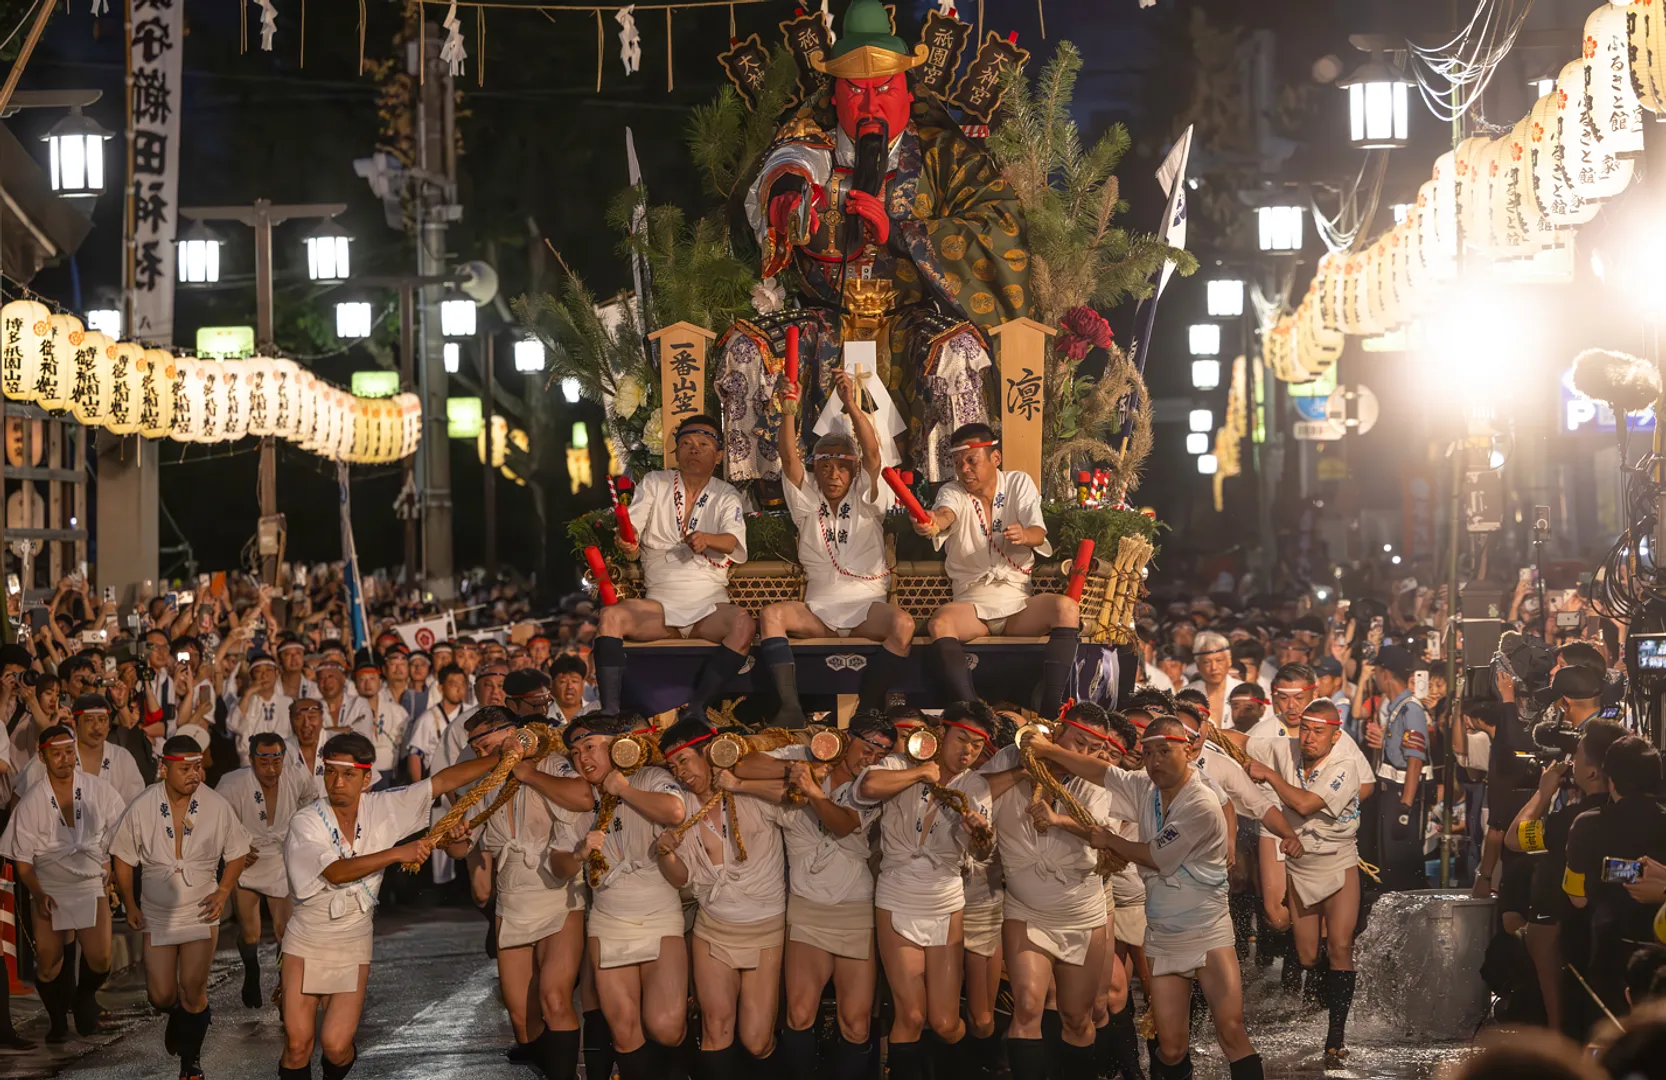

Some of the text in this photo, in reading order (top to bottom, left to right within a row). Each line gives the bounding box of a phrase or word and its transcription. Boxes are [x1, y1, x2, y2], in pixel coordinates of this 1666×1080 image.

[738, 55, 765, 93] 大神
[797, 27, 832, 92] 祇宮
[924, 28, 954, 85] 祇園宮
[970, 52, 1009, 105] 大神宮
[3, 317, 25, 393] 博多祇園山笠
[670, 342, 701, 453] 一番山笠
[1007, 367, 1042, 421] 凛
[838, 502, 851, 544] 東流
